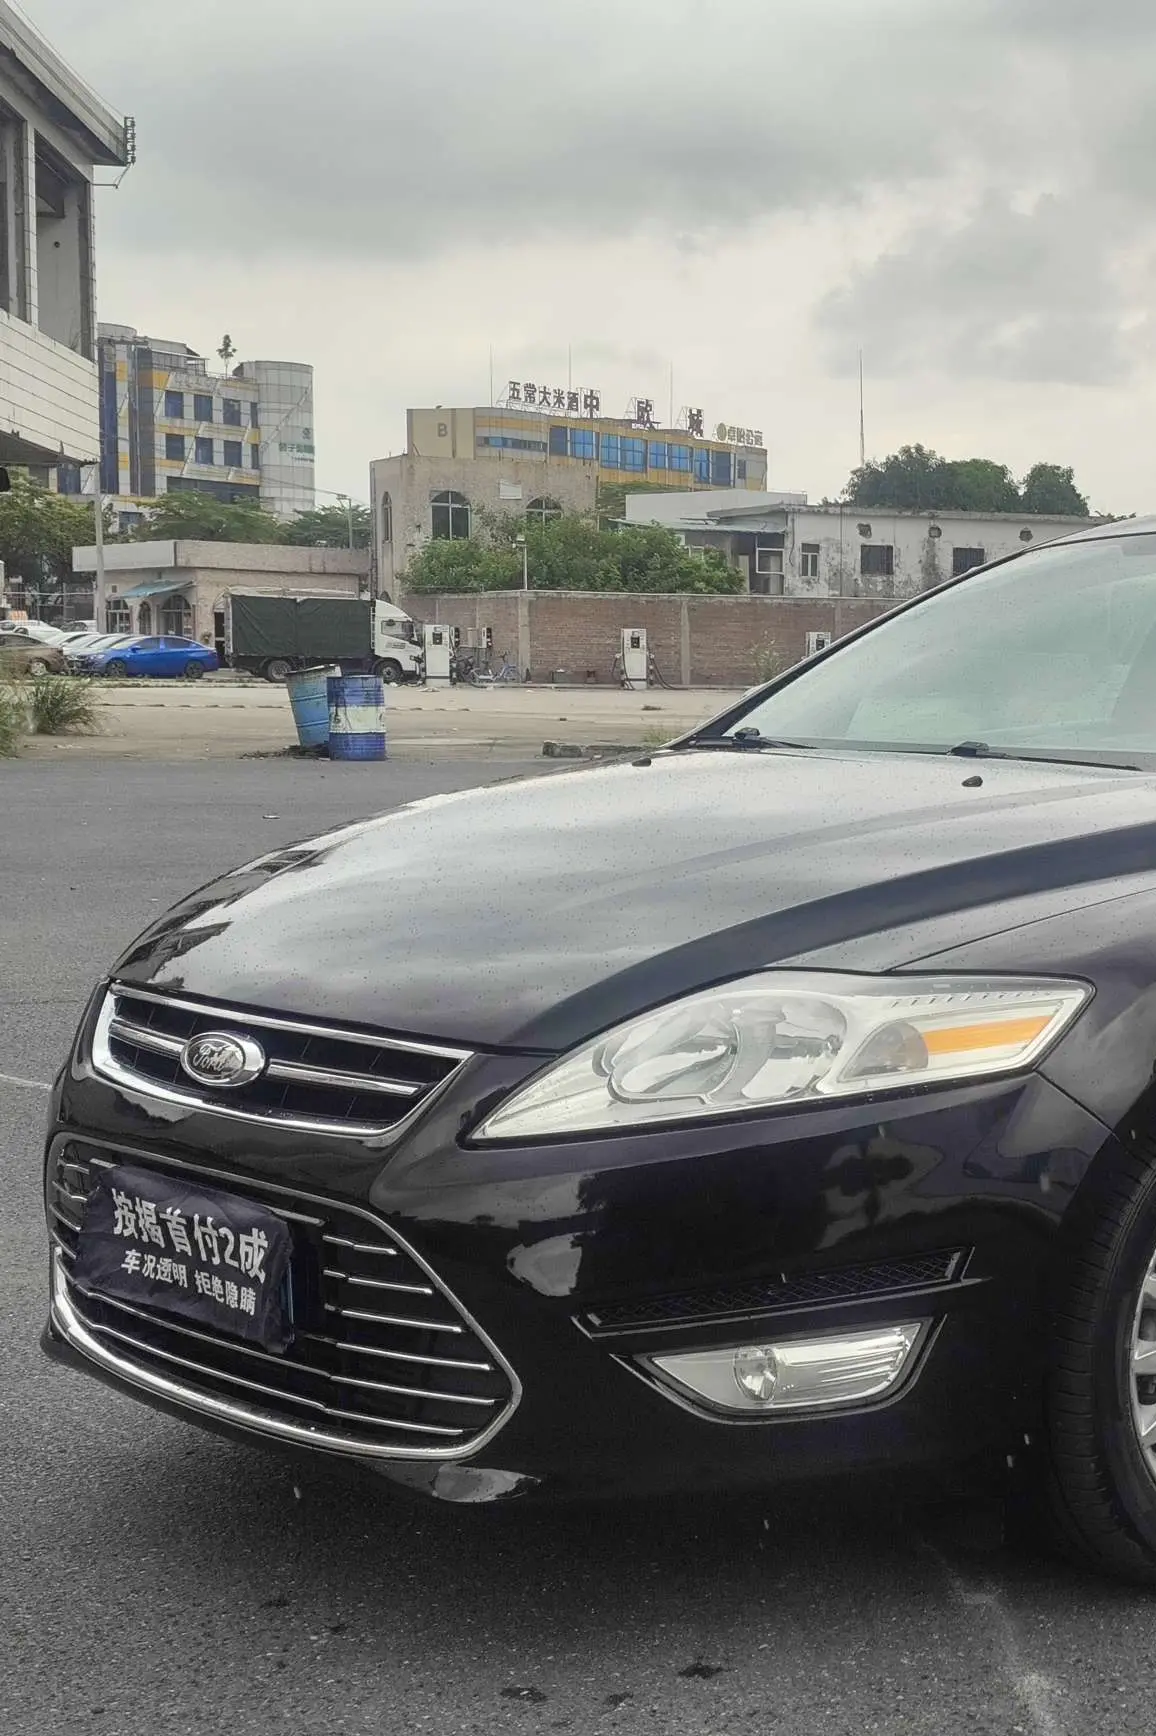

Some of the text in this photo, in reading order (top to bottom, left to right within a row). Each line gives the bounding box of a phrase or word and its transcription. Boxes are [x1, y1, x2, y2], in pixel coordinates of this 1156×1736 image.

[437, 422, 449, 438] B
[112, 1188, 268, 1284] 按揭首付2成
[121, 1249, 257, 1316] 车况透明 拒绝隐瞒
